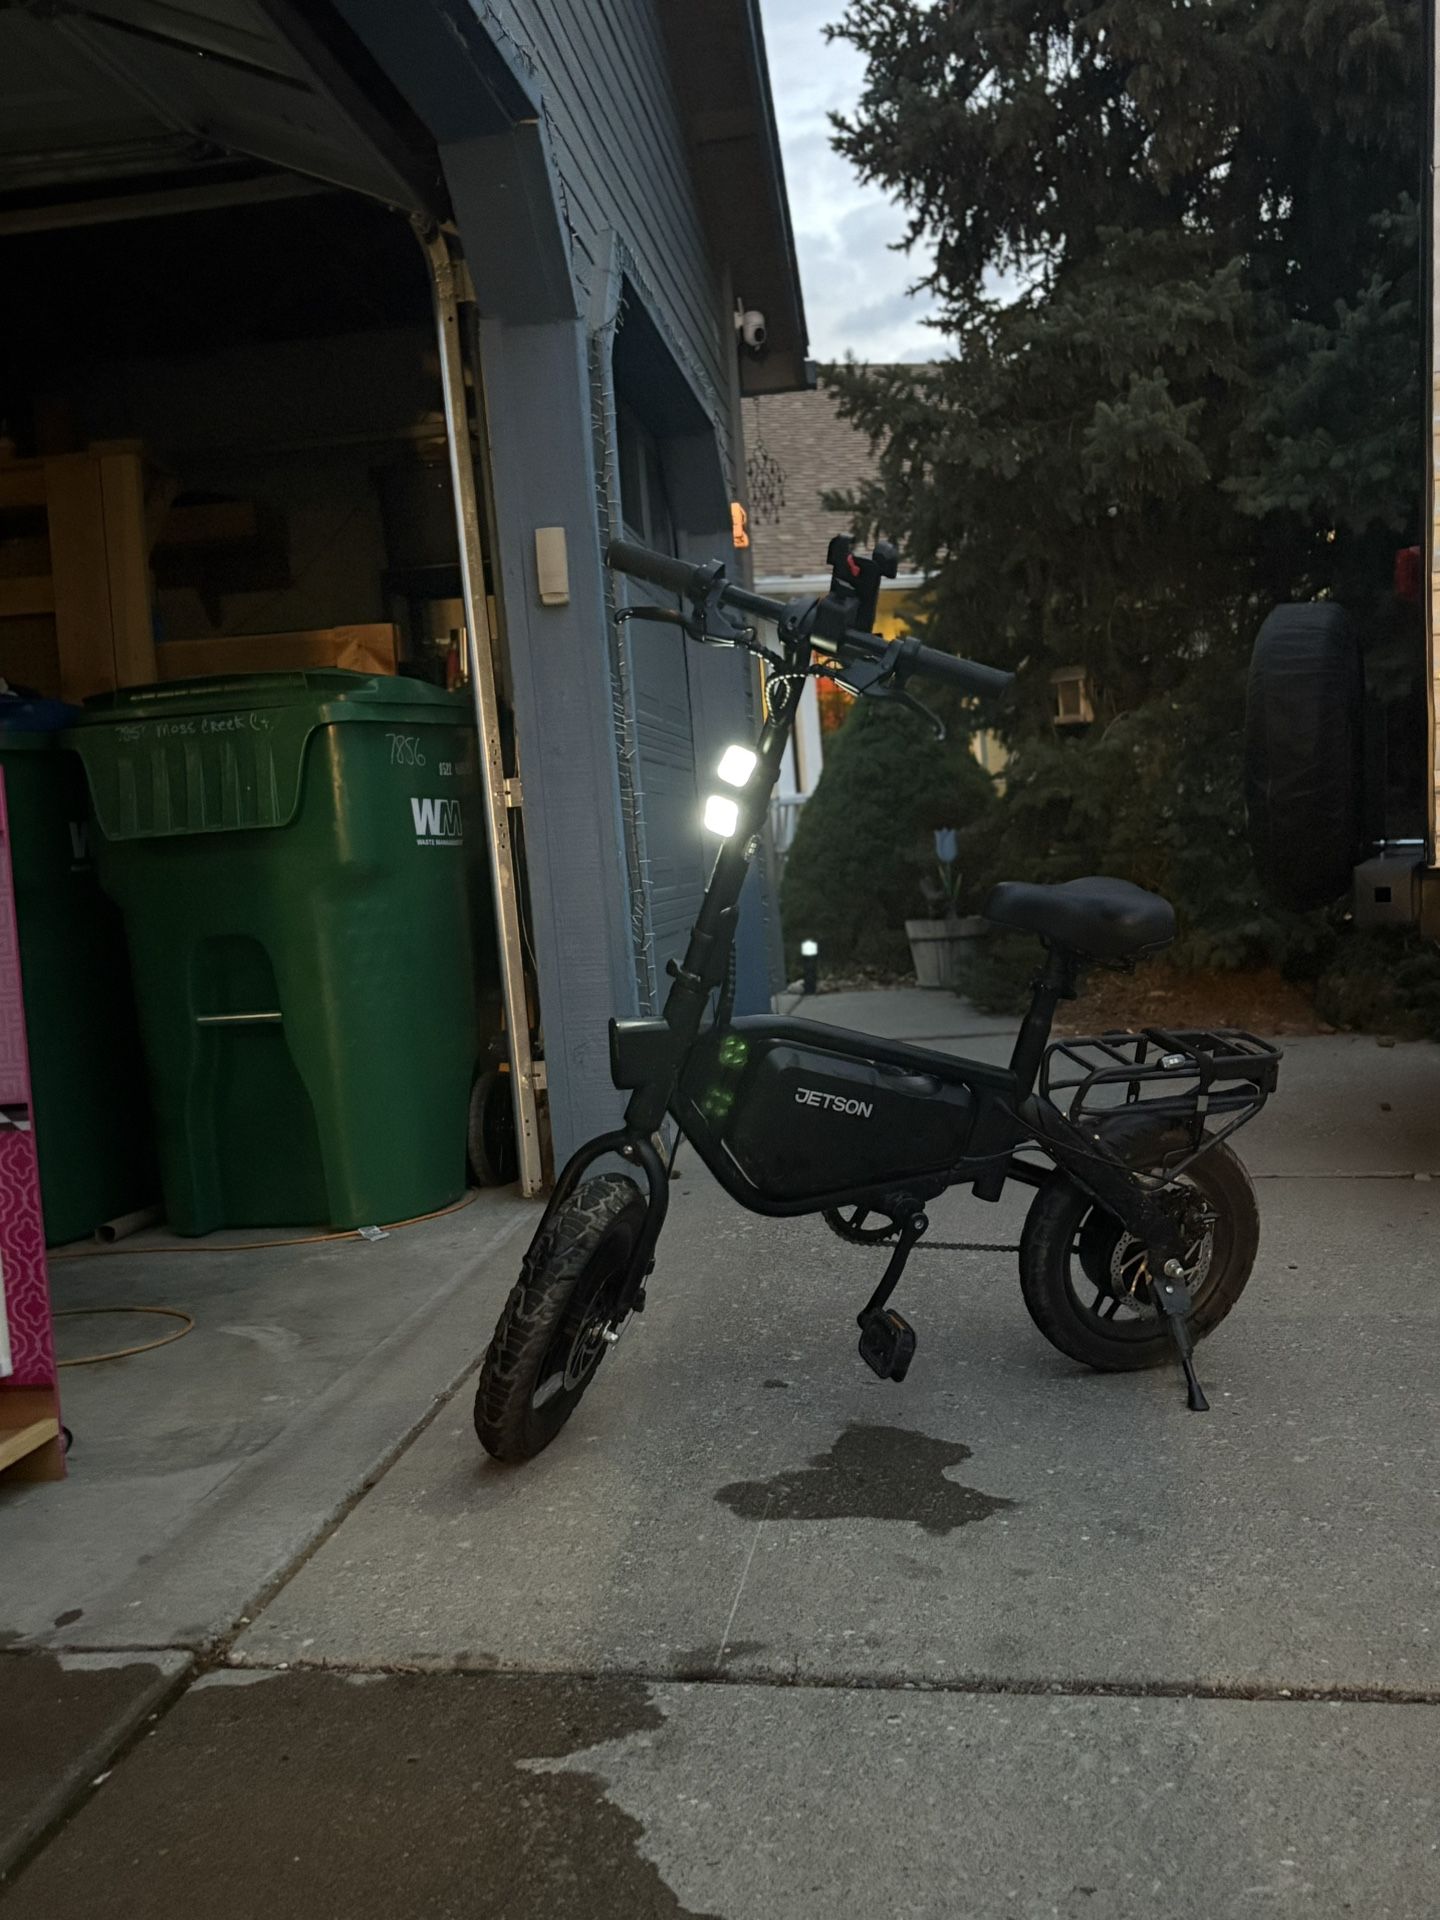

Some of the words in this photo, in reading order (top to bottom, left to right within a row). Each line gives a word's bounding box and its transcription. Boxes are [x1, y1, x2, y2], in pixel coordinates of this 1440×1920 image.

[385, 733, 426, 766] 7856
[410, 797, 463, 836] WM
[795, 1087, 873, 1118] JETSON
